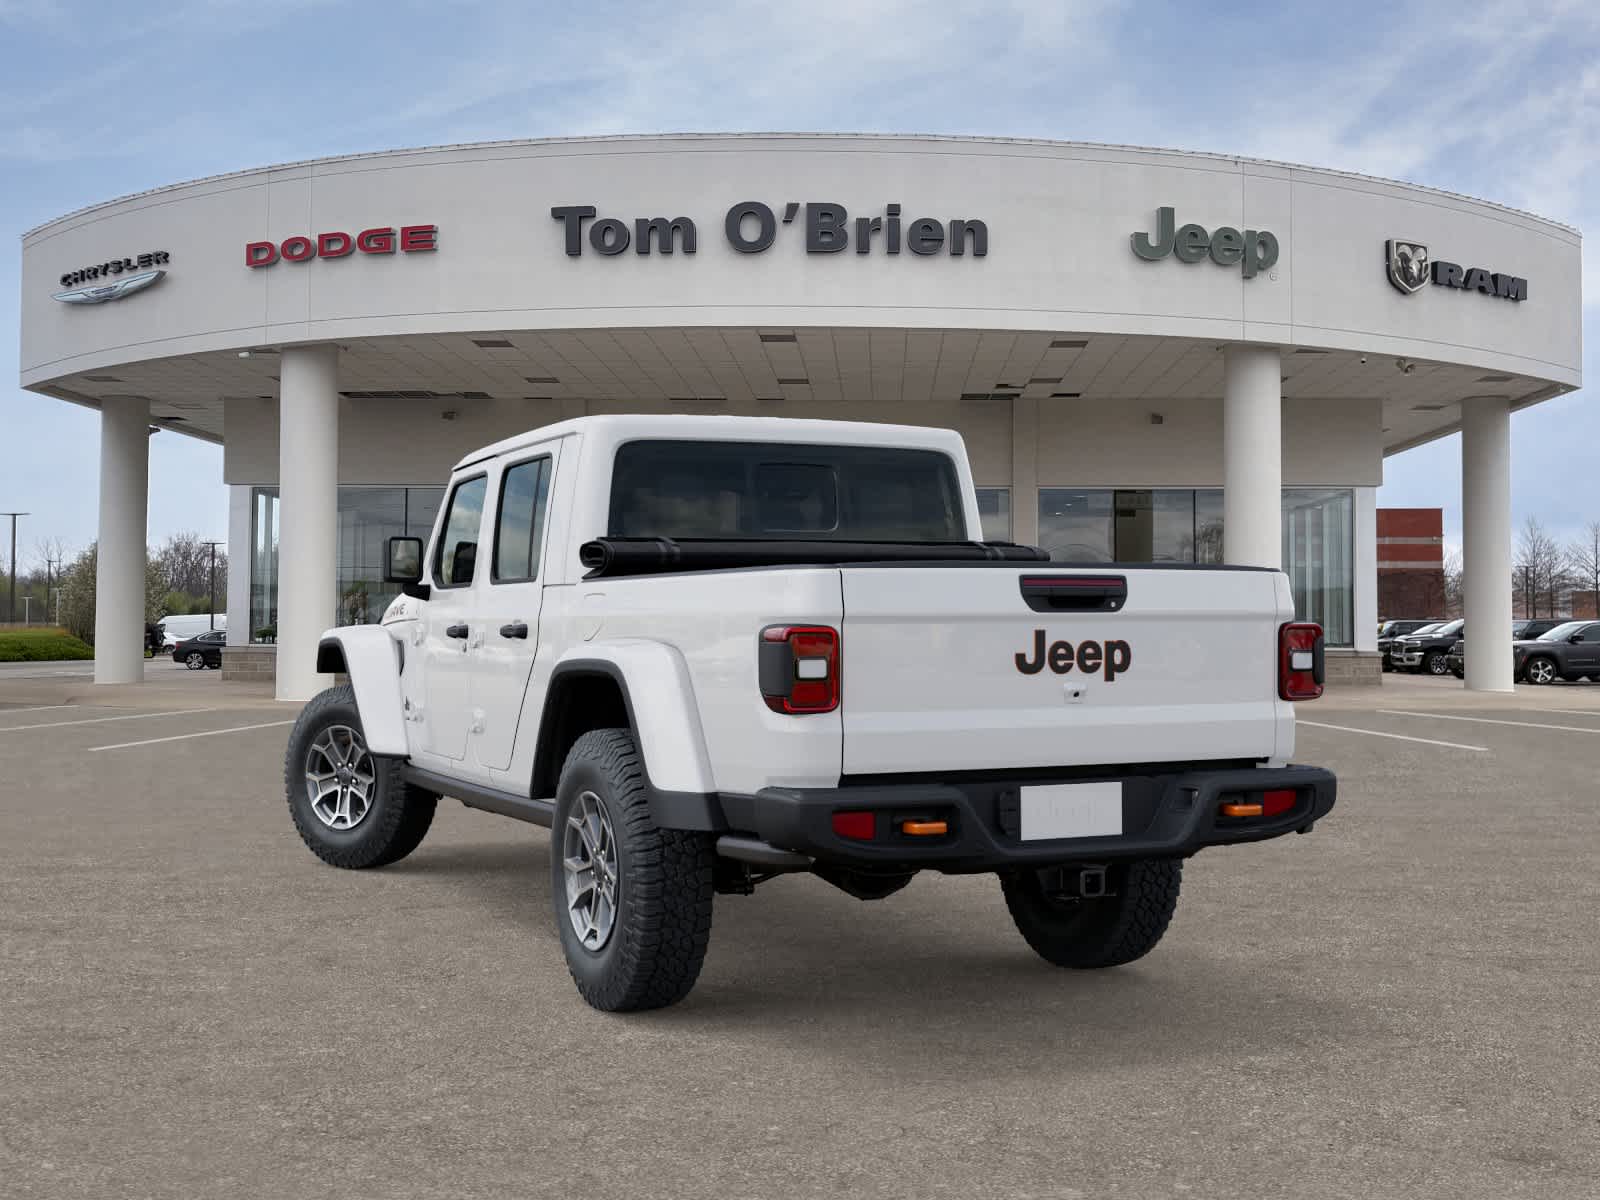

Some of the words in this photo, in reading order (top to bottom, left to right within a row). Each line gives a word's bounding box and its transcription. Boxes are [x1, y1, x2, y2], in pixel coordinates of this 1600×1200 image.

[246, 224, 438, 268] DODGE
[551, 204, 696, 257] Tom
[725, 201, 989, 257] O'Brien
[1130, 206, 1279, 279] Jeep
[60, 251, 170, 287] CHRYSLER
[1431, 260, 1528, 301] RAM
[1014, 629, 1132, 682] Jeep
